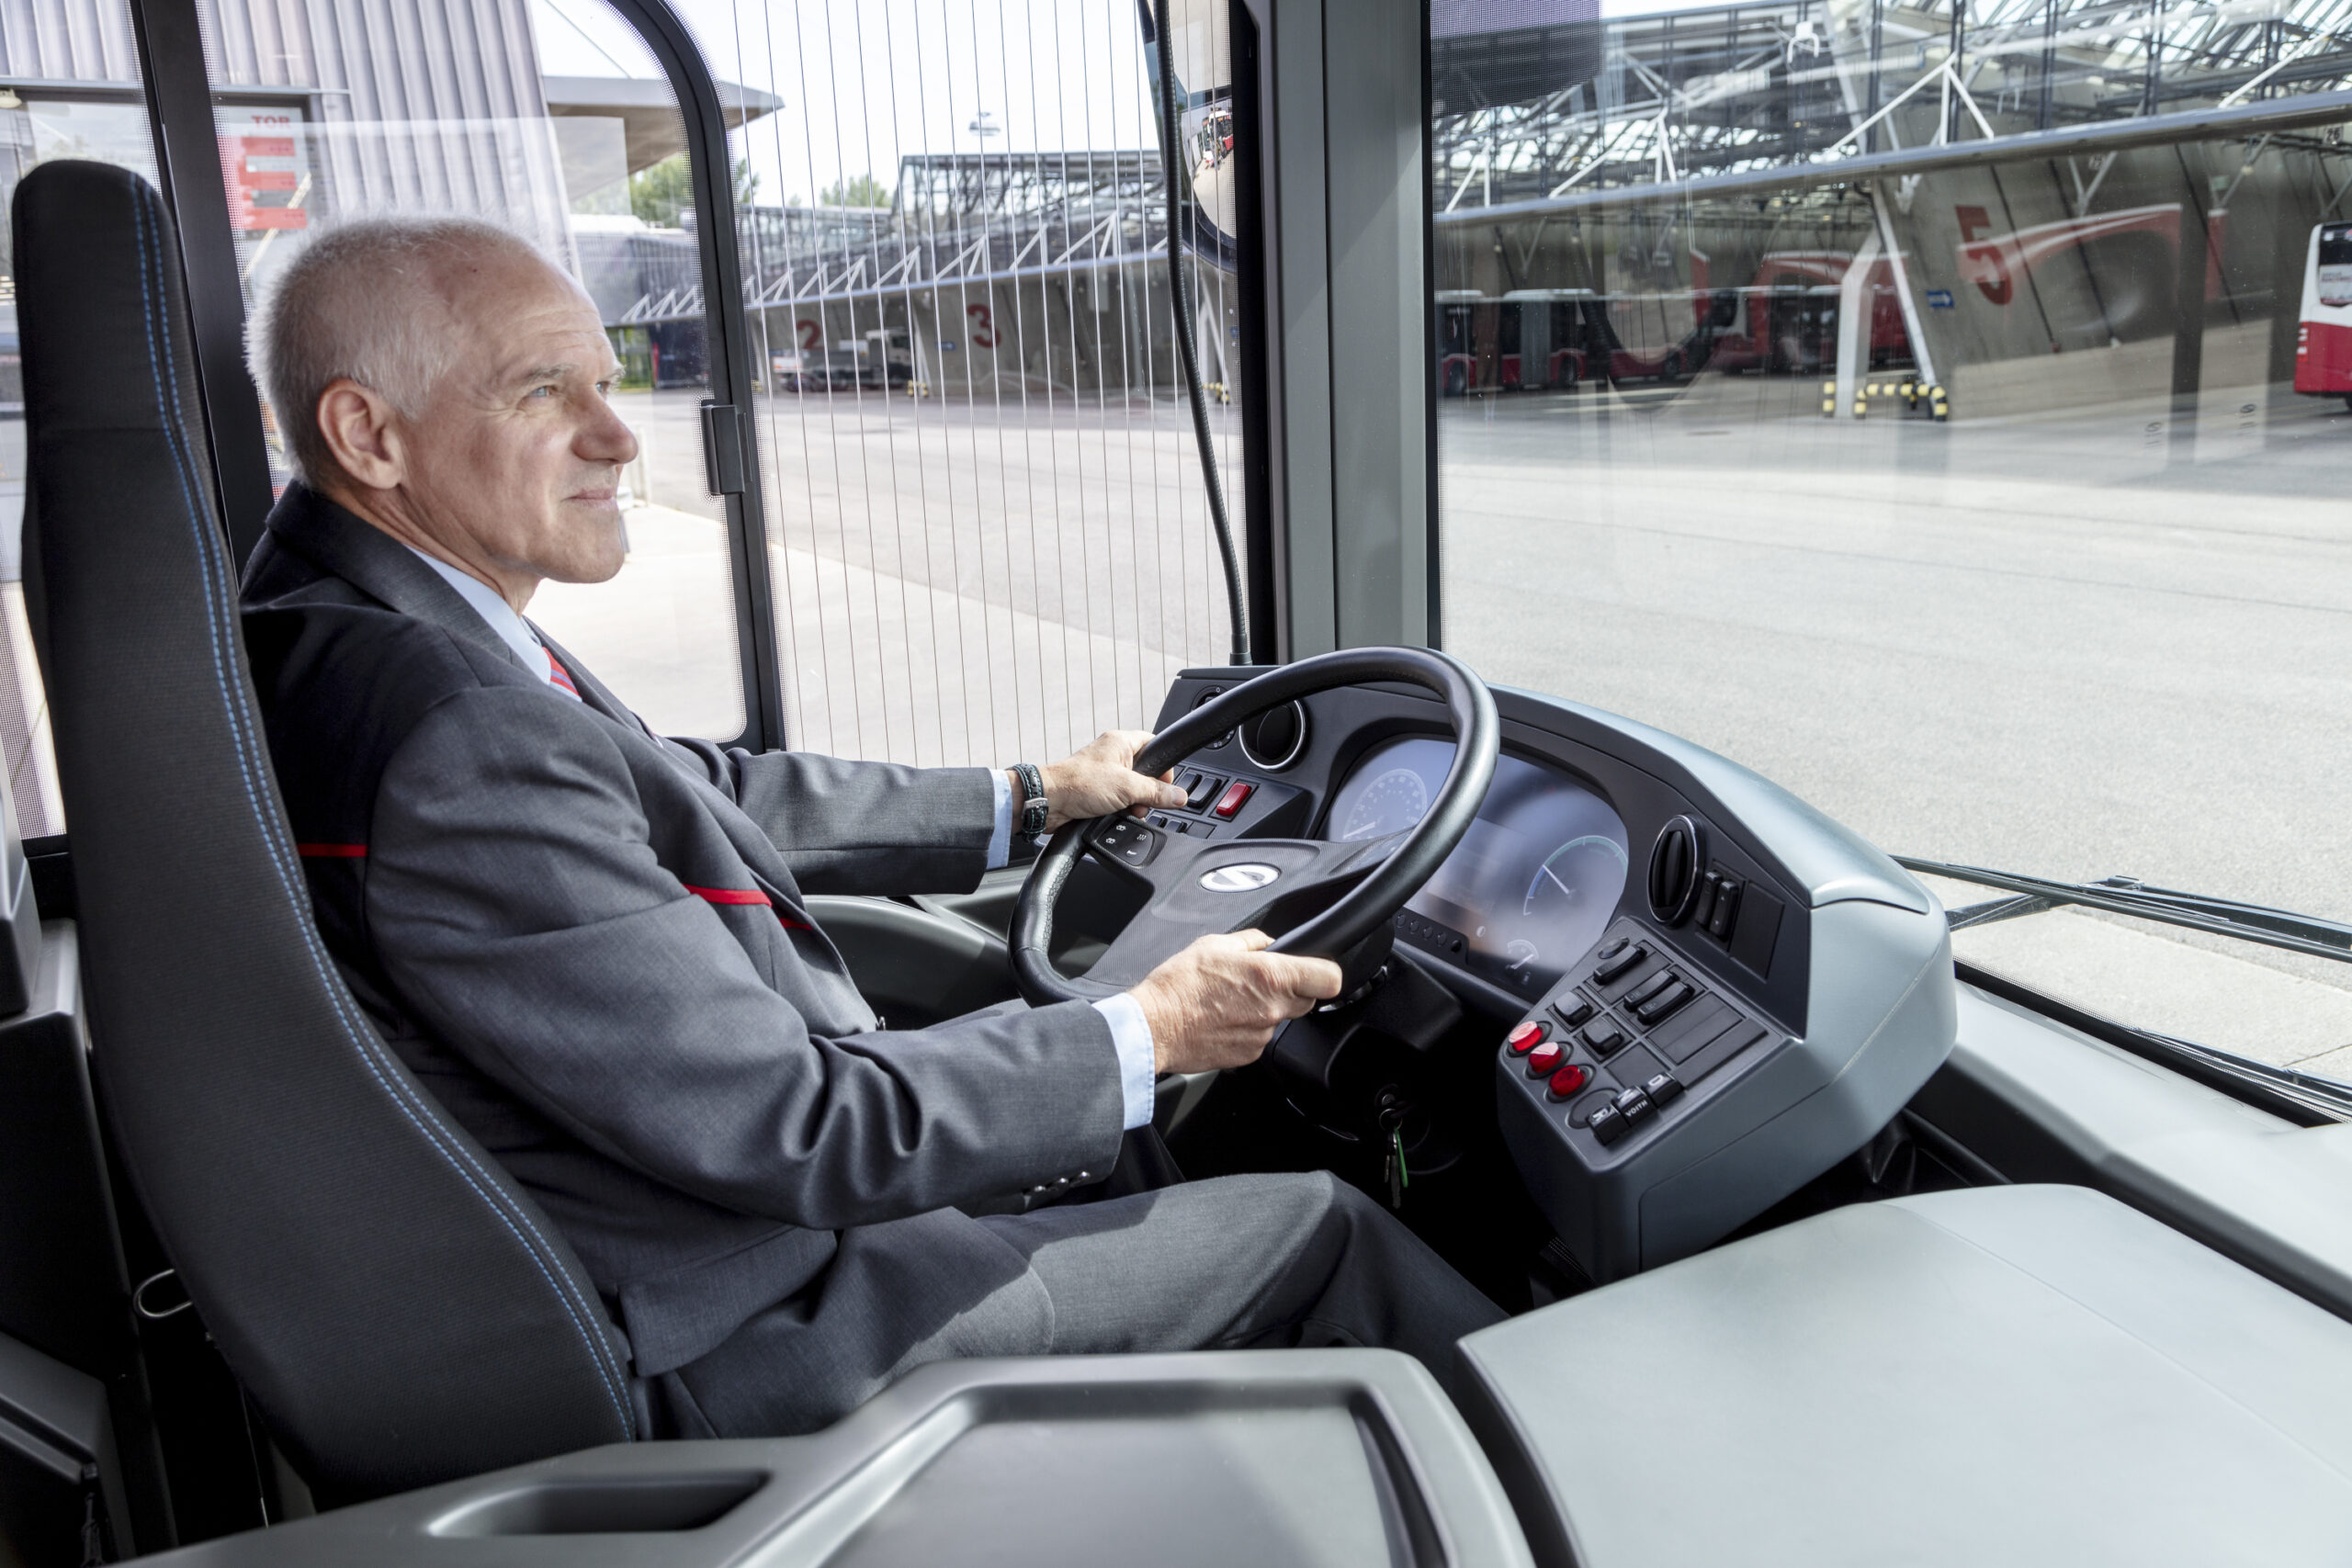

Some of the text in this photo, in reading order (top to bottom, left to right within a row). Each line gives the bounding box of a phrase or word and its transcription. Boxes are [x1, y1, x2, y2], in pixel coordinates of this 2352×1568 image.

[252, 115, 291, 128] TOR
[1954, 205, 2013, 306] 5
[796, 319, 824, 351] 2
[967, 303, 1001, 348] 3
[1624, 1100, 1648, 1117] VOITH
